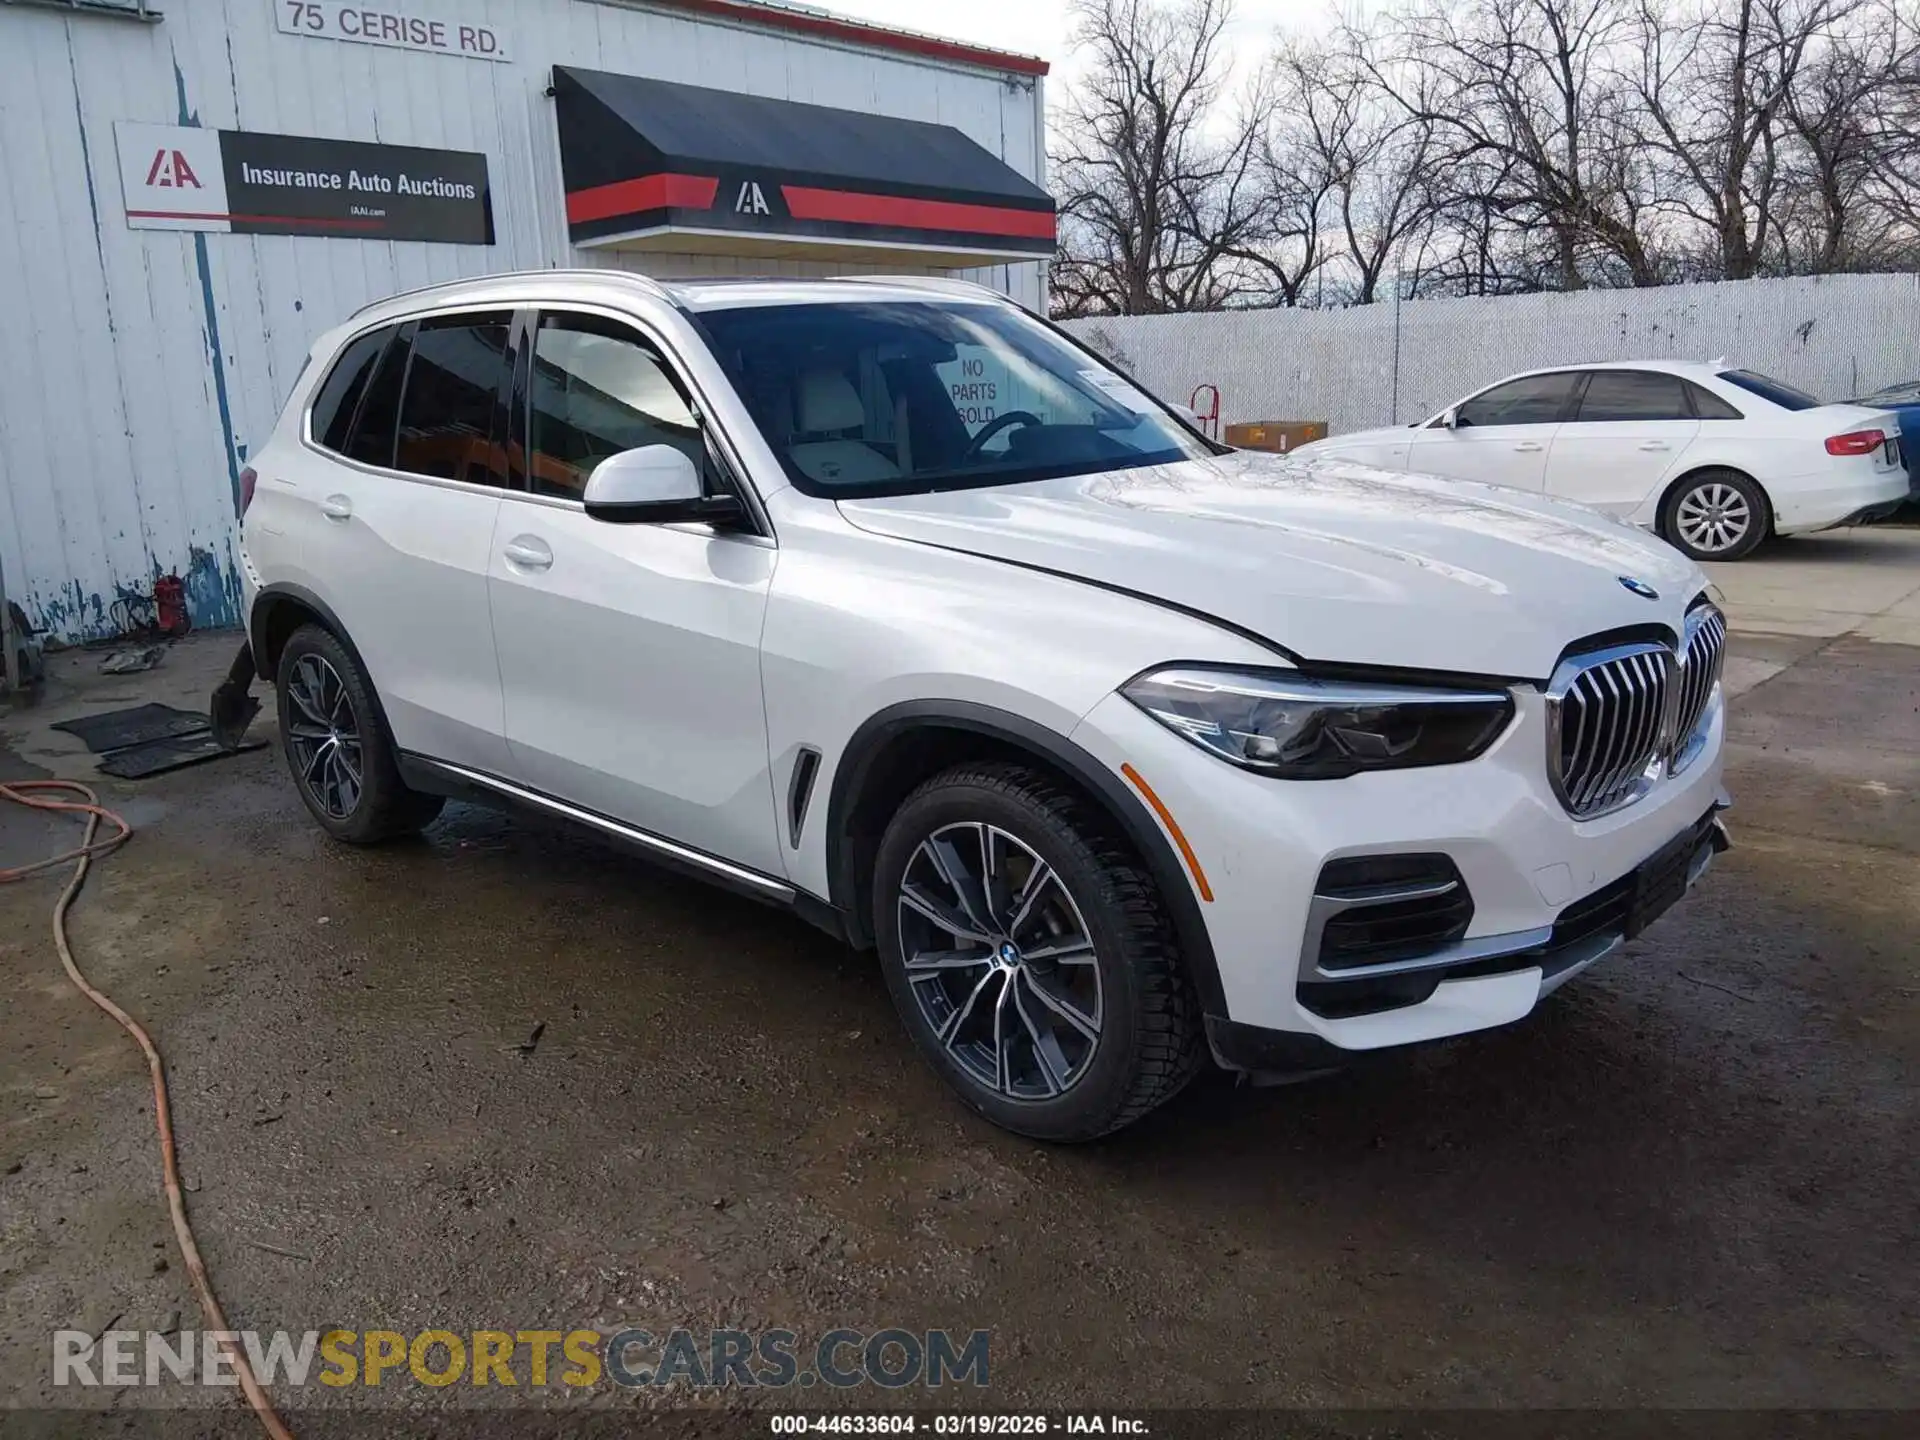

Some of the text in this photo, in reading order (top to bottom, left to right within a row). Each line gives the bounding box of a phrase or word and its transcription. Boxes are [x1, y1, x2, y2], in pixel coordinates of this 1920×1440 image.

[287, 1, 504, 55] 75 CERISE RD.
[242, 162, 475, 199] Insurance Auto Auctions
[350, 205, 386, 217] IAAI.com
[962, 359, 984, 377] NO
[952, 382, 996, 401] PARTS
[958, 406, 995, 424] SOLD
